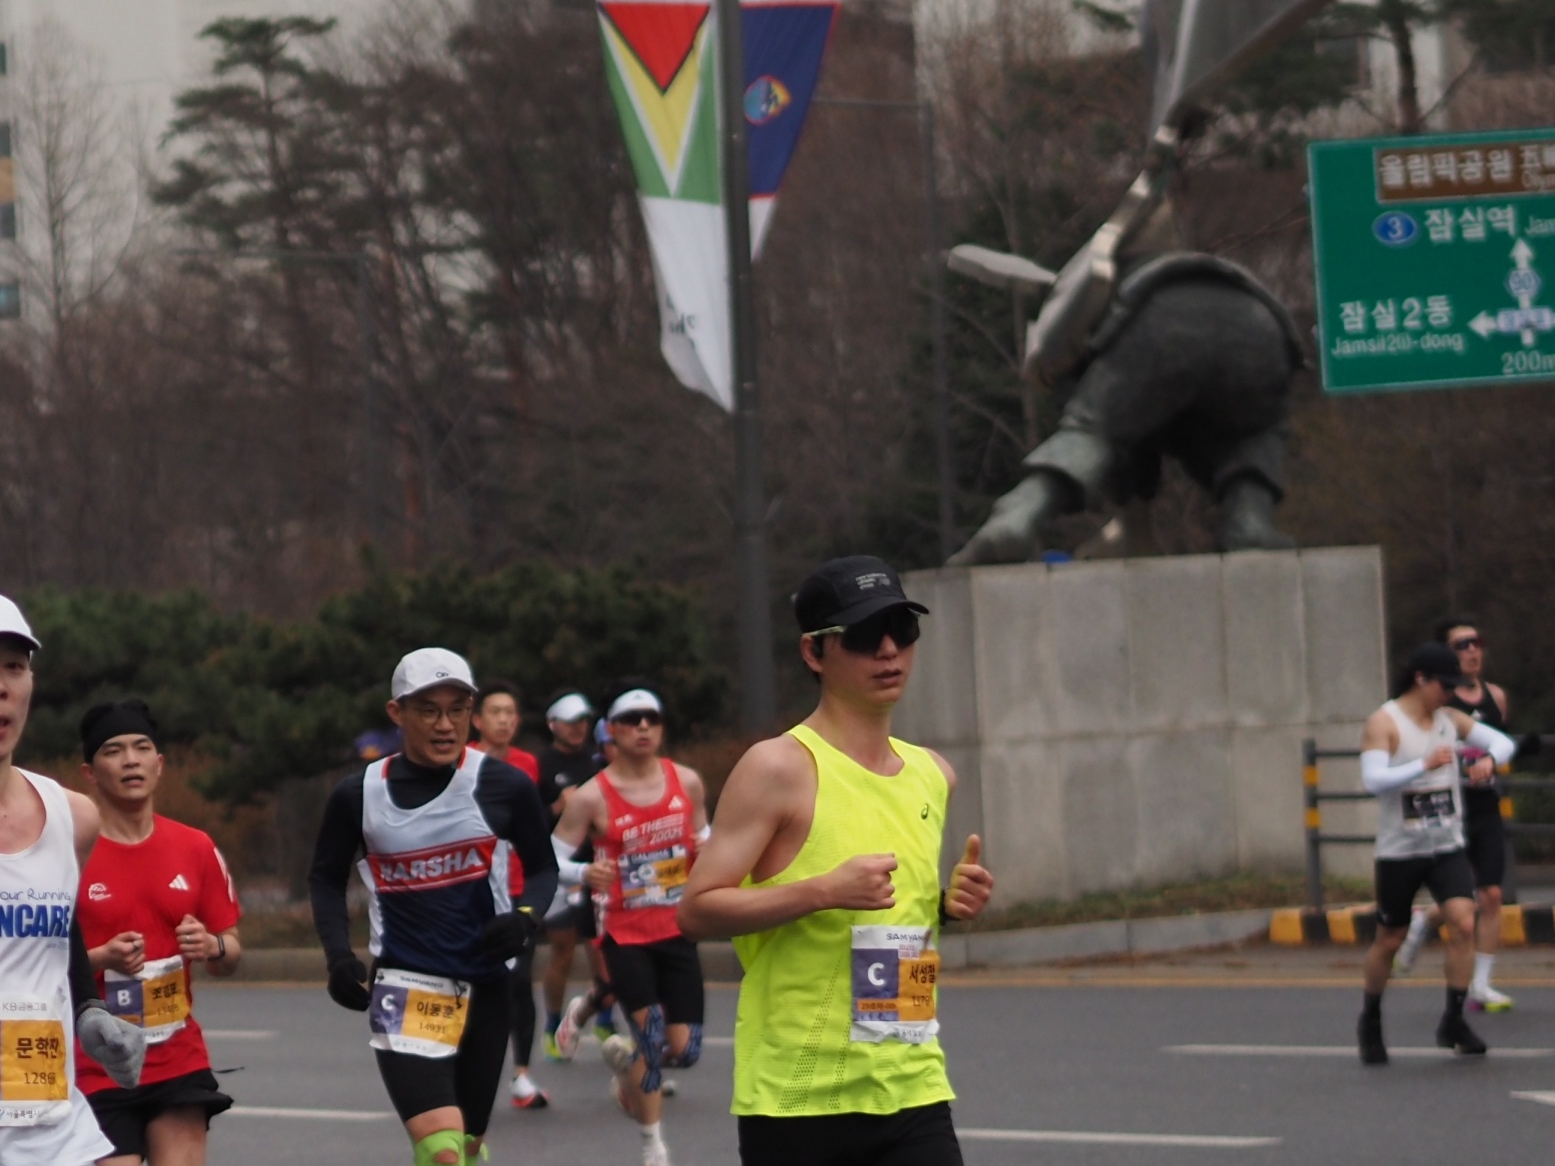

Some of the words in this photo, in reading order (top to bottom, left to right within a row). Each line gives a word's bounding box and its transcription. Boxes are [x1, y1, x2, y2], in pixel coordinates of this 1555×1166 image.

[1380, 149, 1512, 187] 올림픽공원
[1425, 206, 1516, 243] 잠실역
[1339, 295, 1452, 332] 잠실2동
[27, 888, 71, 901] Running
[886, 933, 929, 942] SAMYAN
[867, 962, 885, 986] C
[117, 990, 130, 1006] B
[381, 994, 395, 1010] C
